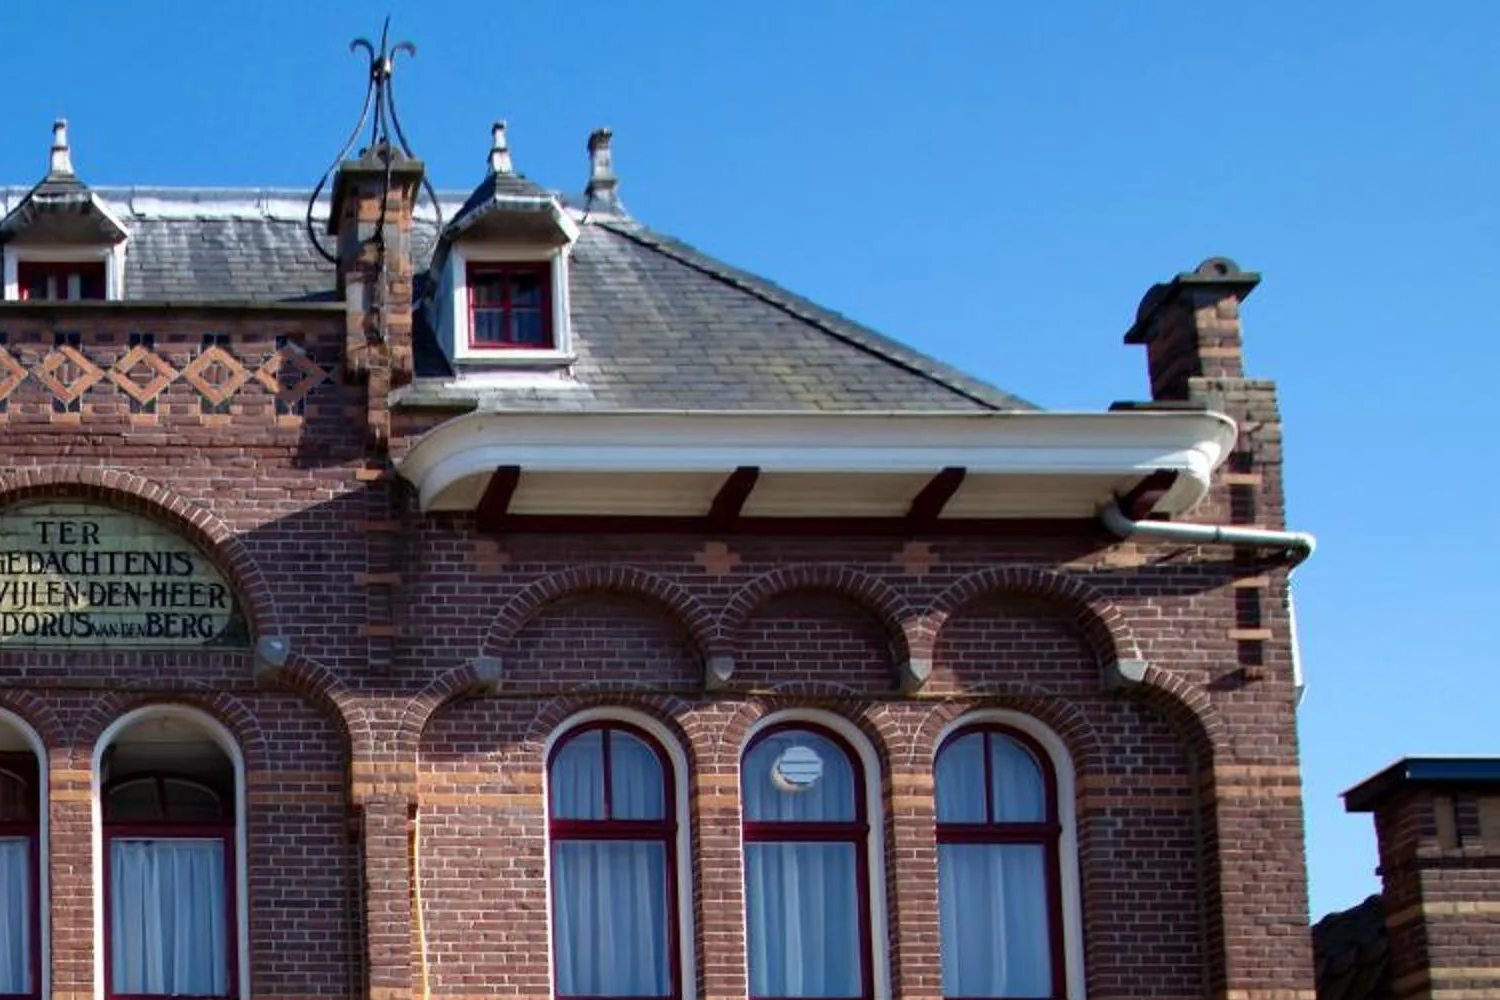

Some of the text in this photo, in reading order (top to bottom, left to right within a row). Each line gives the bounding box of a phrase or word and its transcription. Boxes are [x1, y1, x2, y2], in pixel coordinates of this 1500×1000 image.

[35, 521, 100, 546] TER
[151, 581, 226, 609] HEER
[146, 611, 214, 638] BERG
